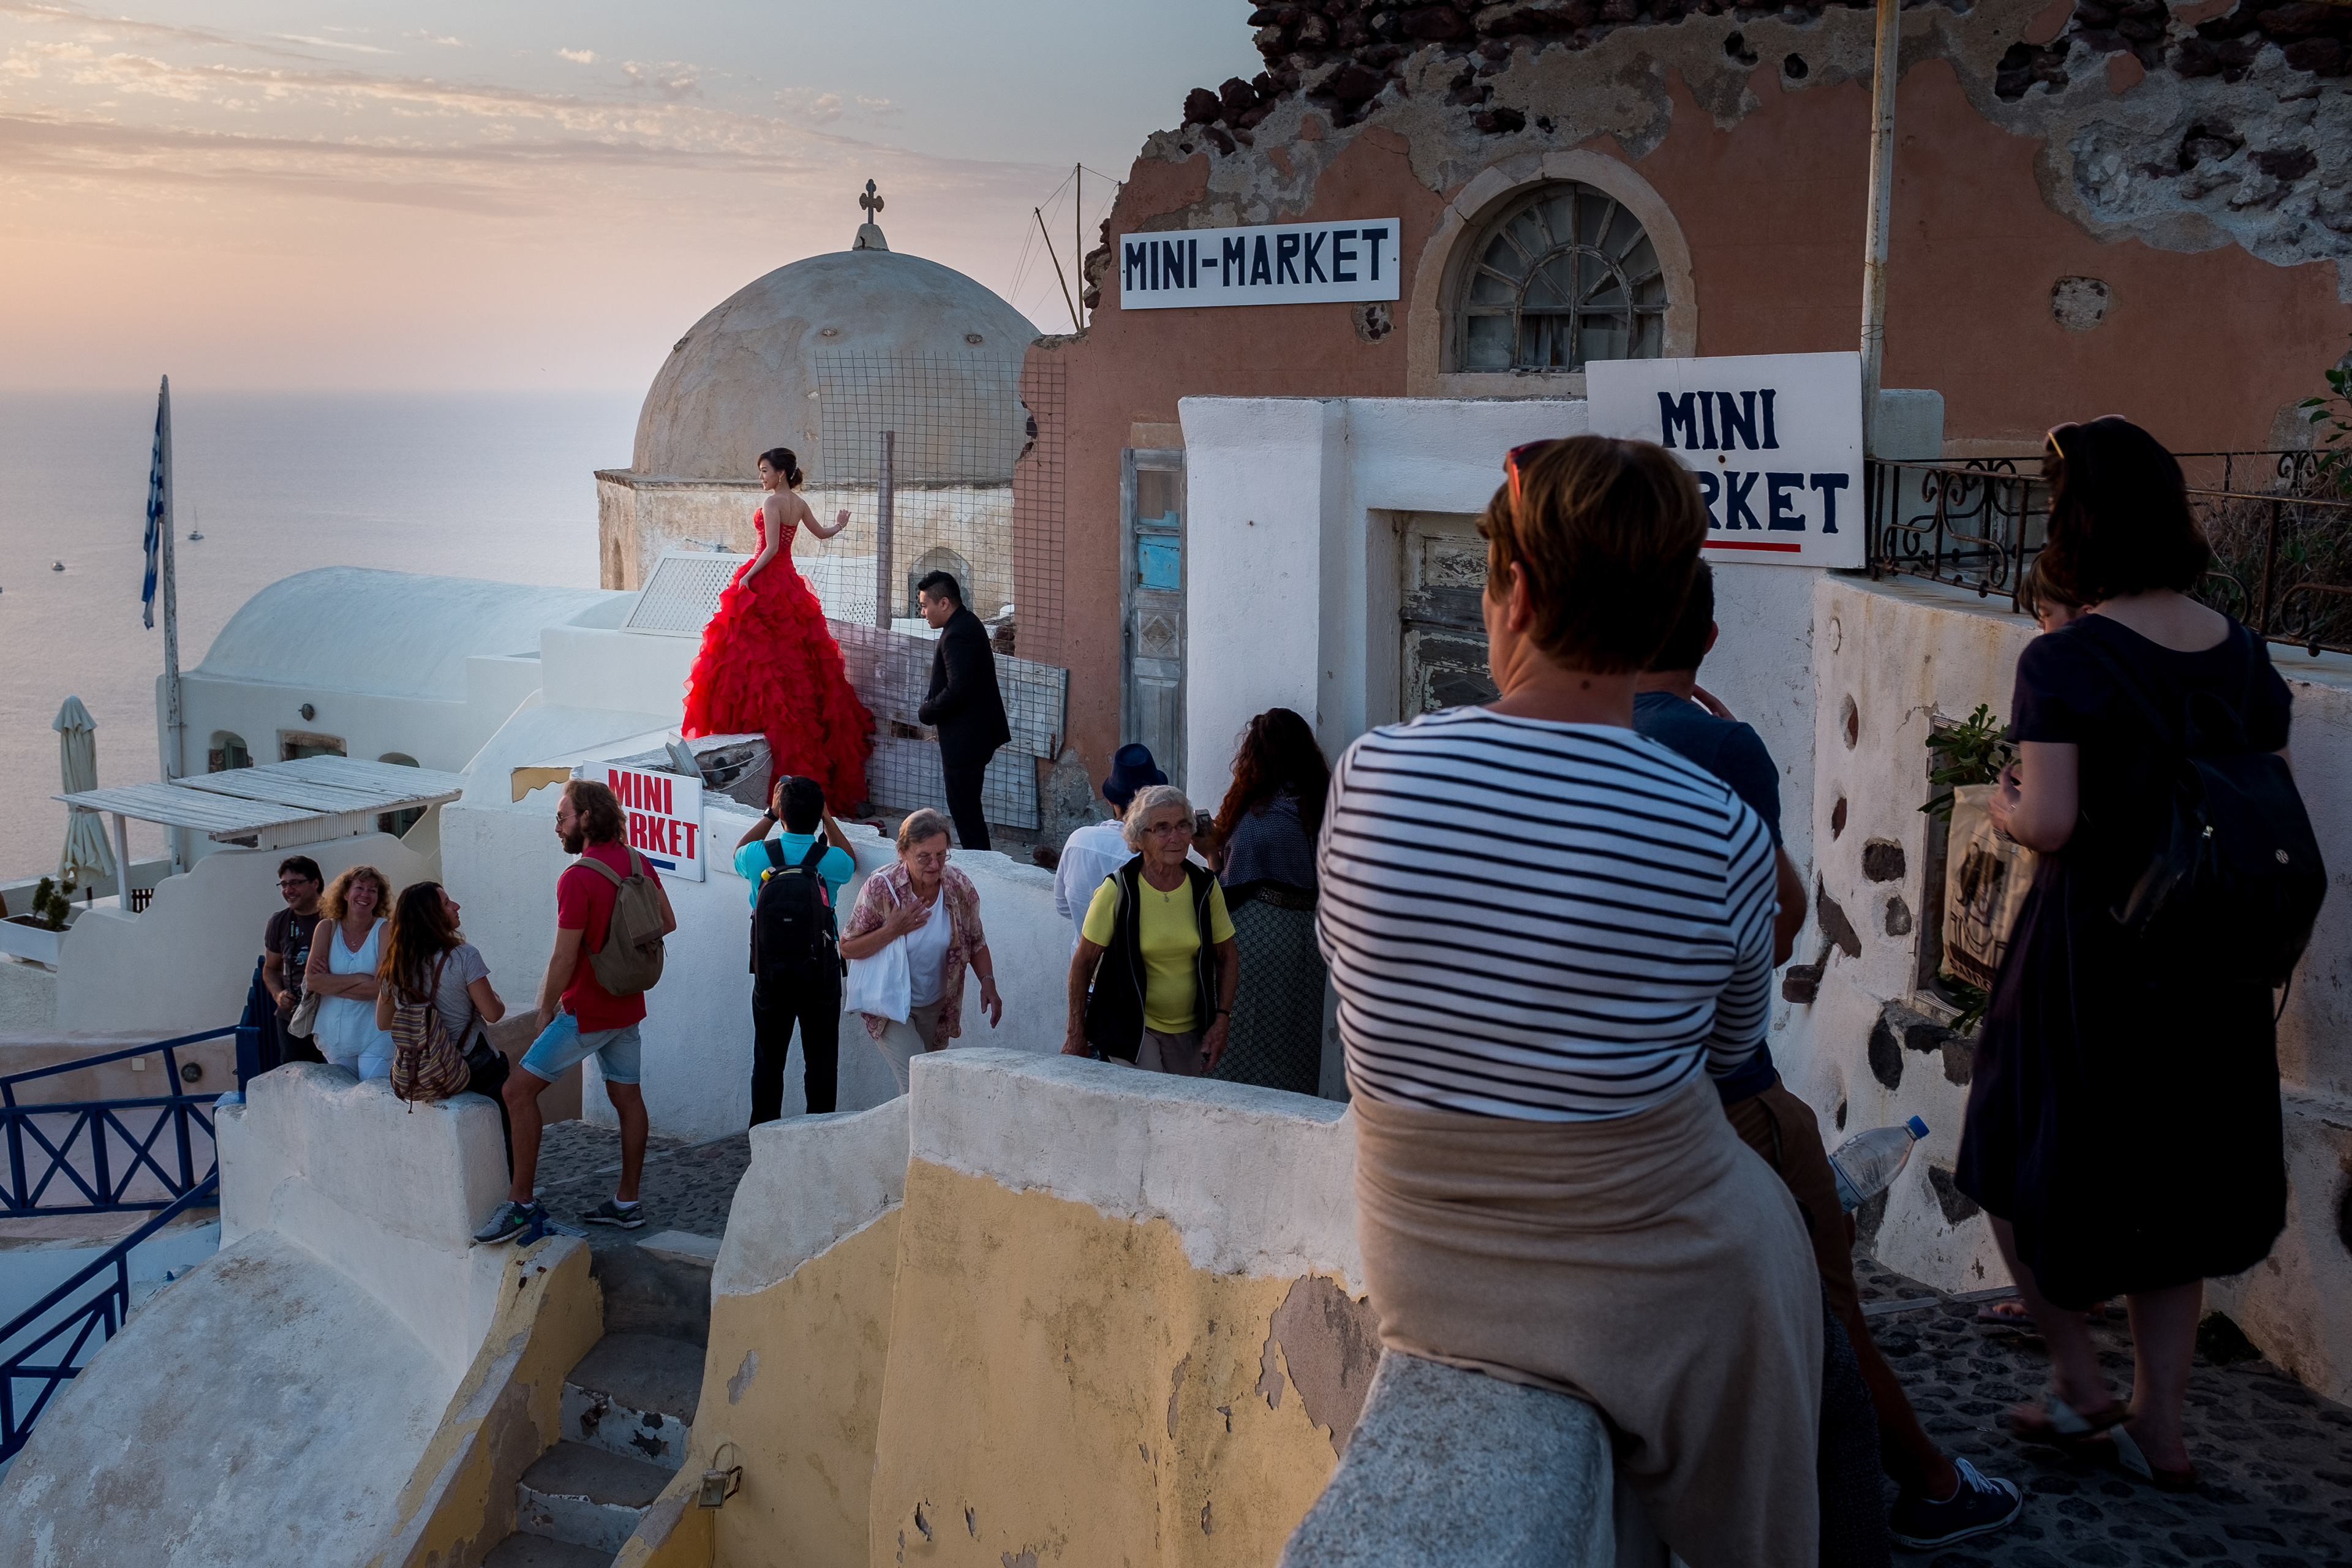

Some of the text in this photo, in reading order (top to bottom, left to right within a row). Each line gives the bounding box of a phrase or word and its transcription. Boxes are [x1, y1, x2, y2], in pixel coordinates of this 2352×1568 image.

[1125, 227, 1389, 291] MINI-MARKET
[1657, 388, 1780, 451] MINI
[1683, 470, 1850, 535] RKET
[608, 768, 673, 815] MINI
[624, 811, 699, 860] RKET
